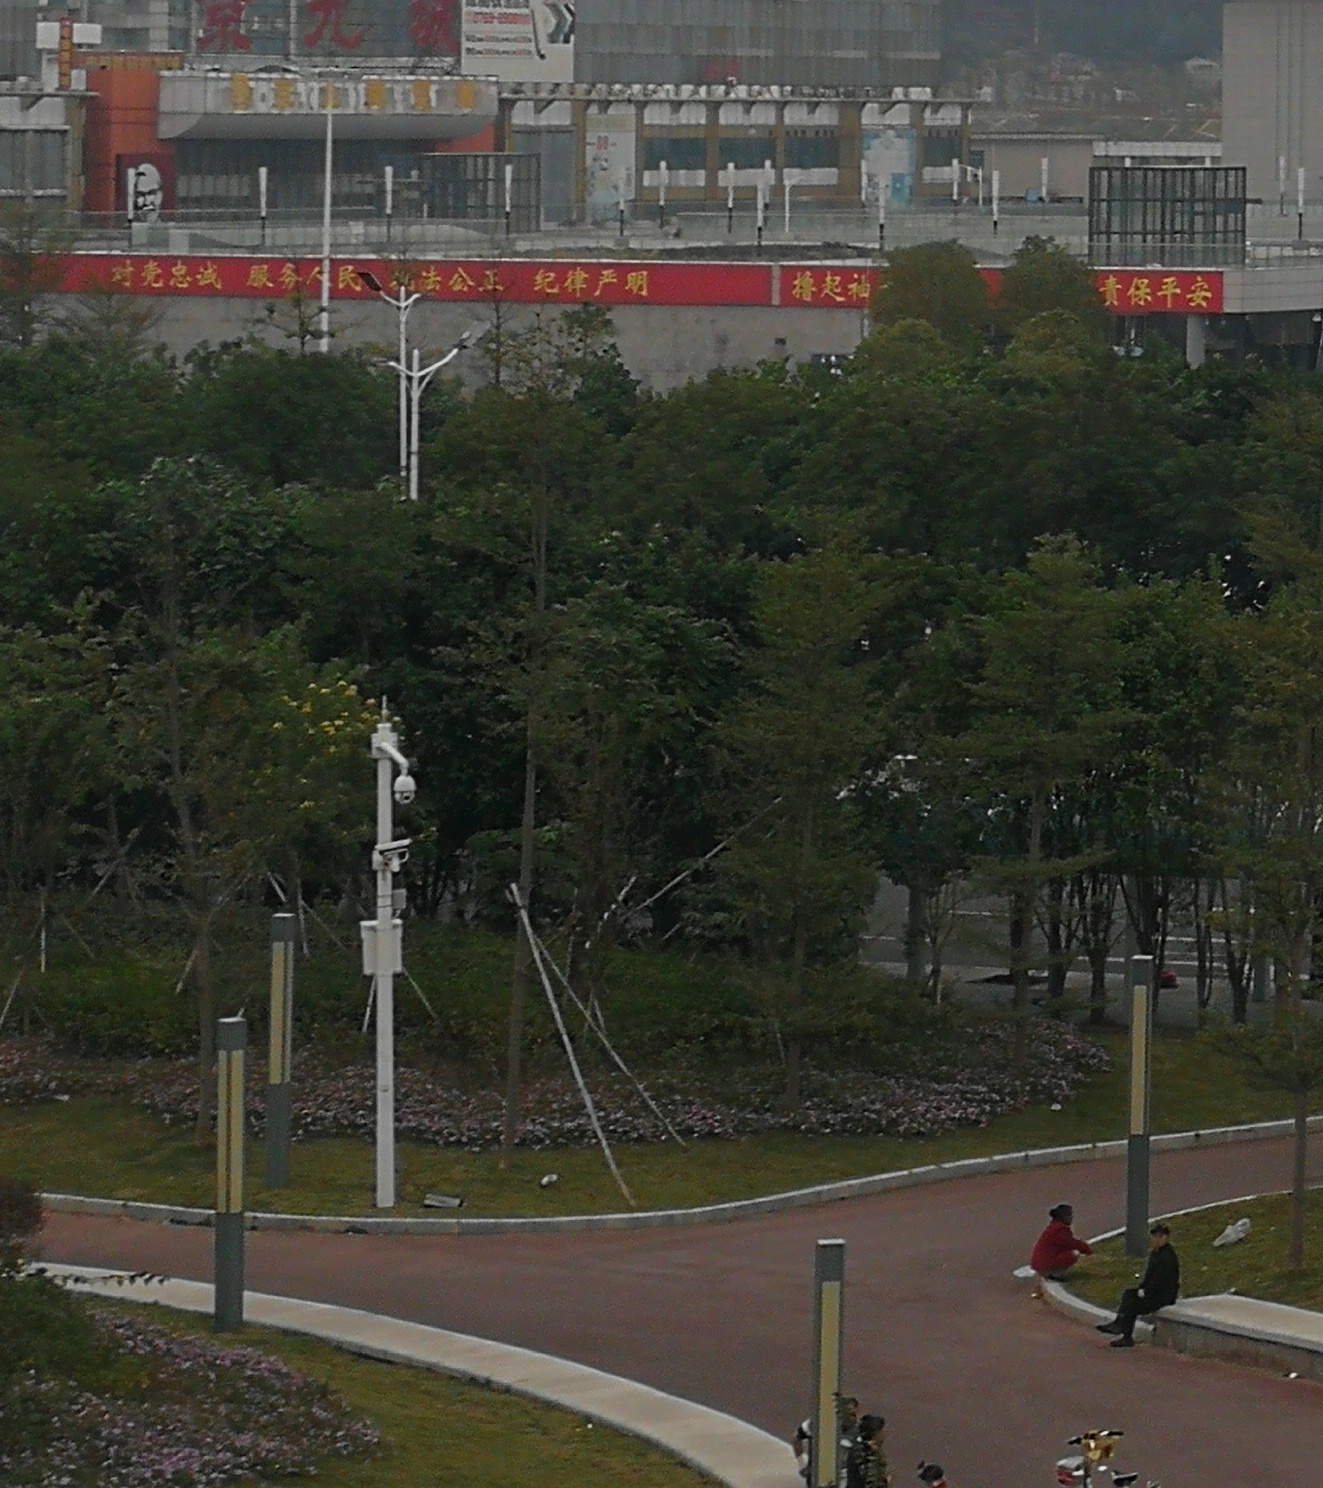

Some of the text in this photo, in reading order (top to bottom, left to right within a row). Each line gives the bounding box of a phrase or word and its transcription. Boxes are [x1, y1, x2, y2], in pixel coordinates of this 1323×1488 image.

[111, 259, 222, 289] 对党忠诚
[246, 262, 362, 292] 服务人民
[533, 266, 650, 298] 纪律严明
[791, 270, 889, 303] 撸起袖
